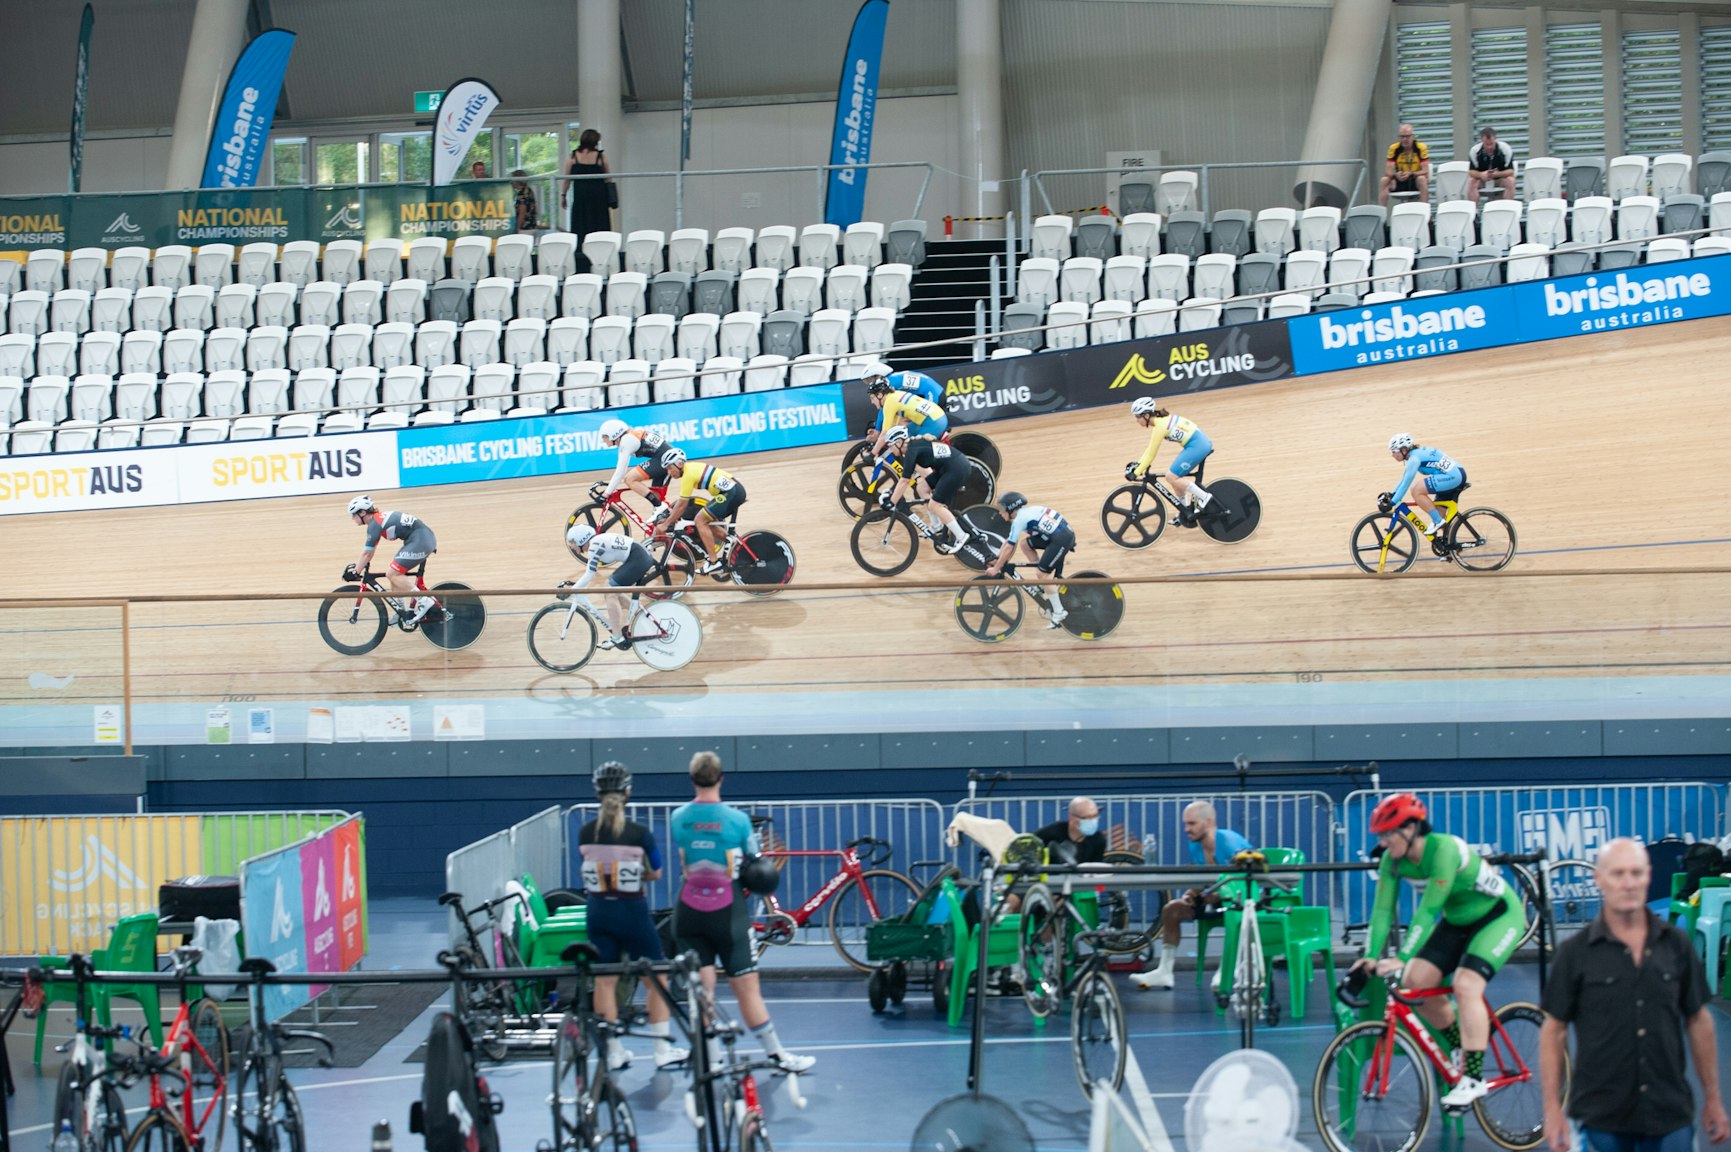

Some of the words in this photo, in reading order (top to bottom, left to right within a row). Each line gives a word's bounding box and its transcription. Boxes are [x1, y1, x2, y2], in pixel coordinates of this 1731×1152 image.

[456, 93, 488, 134] virtus
[838, 59, 868, 186] brisbane
[217, 87, 259, 188] risbane
[1122, 158, 1144, 167] FIRE
[178, 208, 288, 227] NATIONAL
[401, 200, 512, 222] NATIONAL
[178, 226, 288, 239] CHAMPIONSHIPS
[401, 219, 511, 234] CHAMPIONSHIPS
[101, 235, 145, 243] AUSCYCLING
[1544, 271, 1711, 317] brisbane
[1320, 304, 1486, 350] brisbane
[1581, 304, 1683, 332] australia
[1168, 343, 1209, 365] AUS
[1356, 337, 1459, 364] australia
[1169, 353, 1255, 382] CYCLING
[906, 375, 916, 386] 37
[945, 375, 985, 396] AUS
[921, 403, 931, 413] 41
[946, 385, 1031, 414] CYCLING
[702, 412, 767, 438] CYCLING
[768, 403, 841, 430] FESTIVAL
[649, 436, 660, 445] 39
[1172, 429, 1184, 440] 30
[402, 441, 477, 469] BRISBANE
[478, 435, 543, 461] CYCLING
[936, 445, 947, 455] 28
[212, 448, 363, 487] SPORTAUS
[1440, 458, 1451, 470] 33
[718, 477, 729, 489] 36
[1155, 482, 1180, 506] DOLAN
[908, 513, 931, 537] BMC
[1042, 521, 1054, 531] 46
[1411, 517, 1427, 533] LOO
[614, 536, 626, 546] 43
[1296, 673, 1323, 683] 190
[620, 868, 638, 885] 12
[1484, 876, 1499, 890] 10
